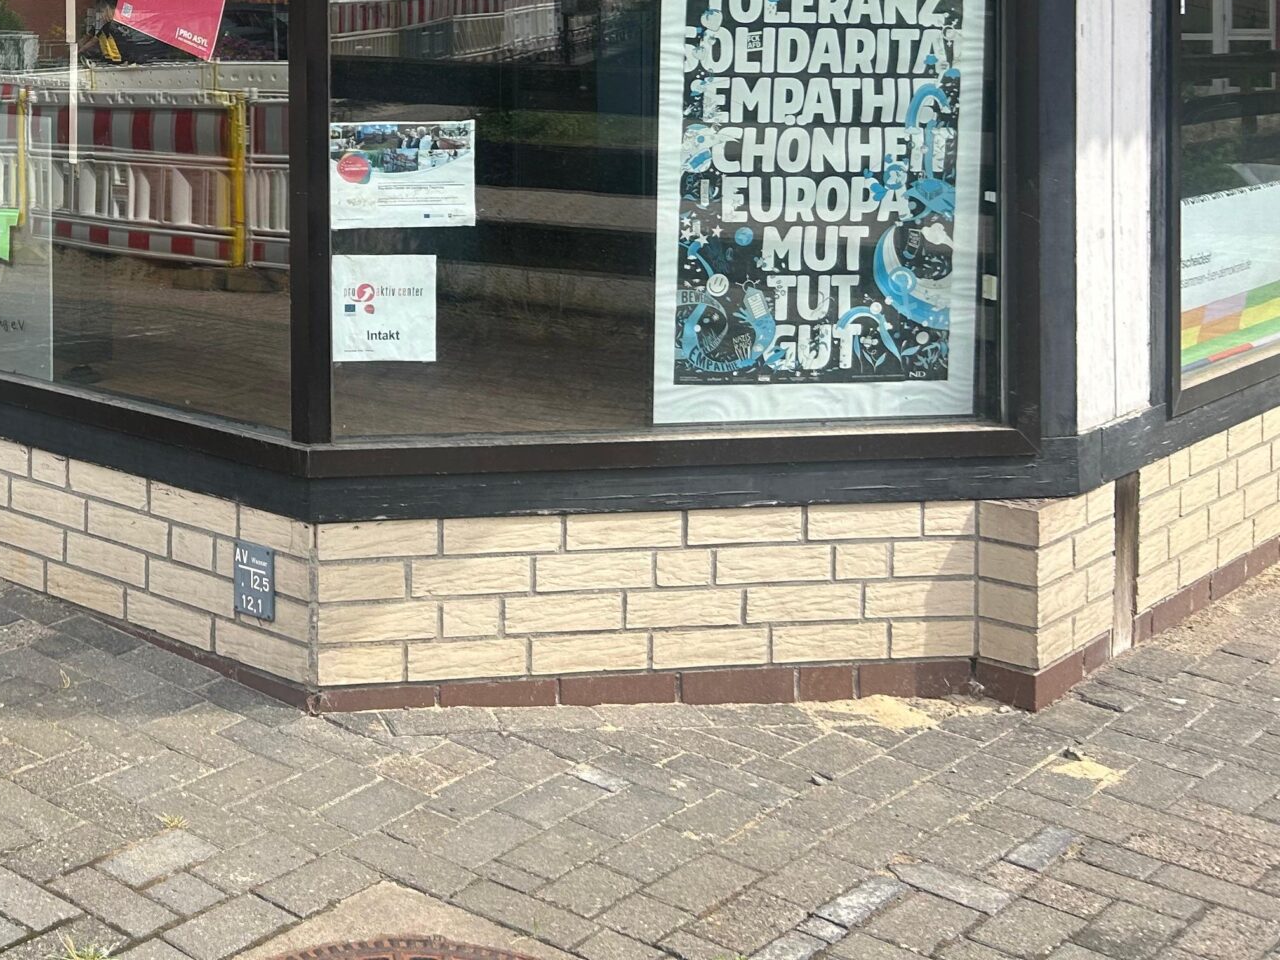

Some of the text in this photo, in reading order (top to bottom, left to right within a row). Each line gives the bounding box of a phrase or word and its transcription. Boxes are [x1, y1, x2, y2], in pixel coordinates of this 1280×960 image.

[179, 28, 193, 40] PRO
[192, 35, 209, 48] ASYL
[683, 115, 957, 173] CHÖNHEIT
[721, 176, 912, 224] EUROPA
[761, 225, 870, 272] MUT
[766, 274, 860, 321] TUT
[366, 329, 401, 341] Intakt
[762, 323, 862, 371] GUT
[235, 547, 248, 564] AV
